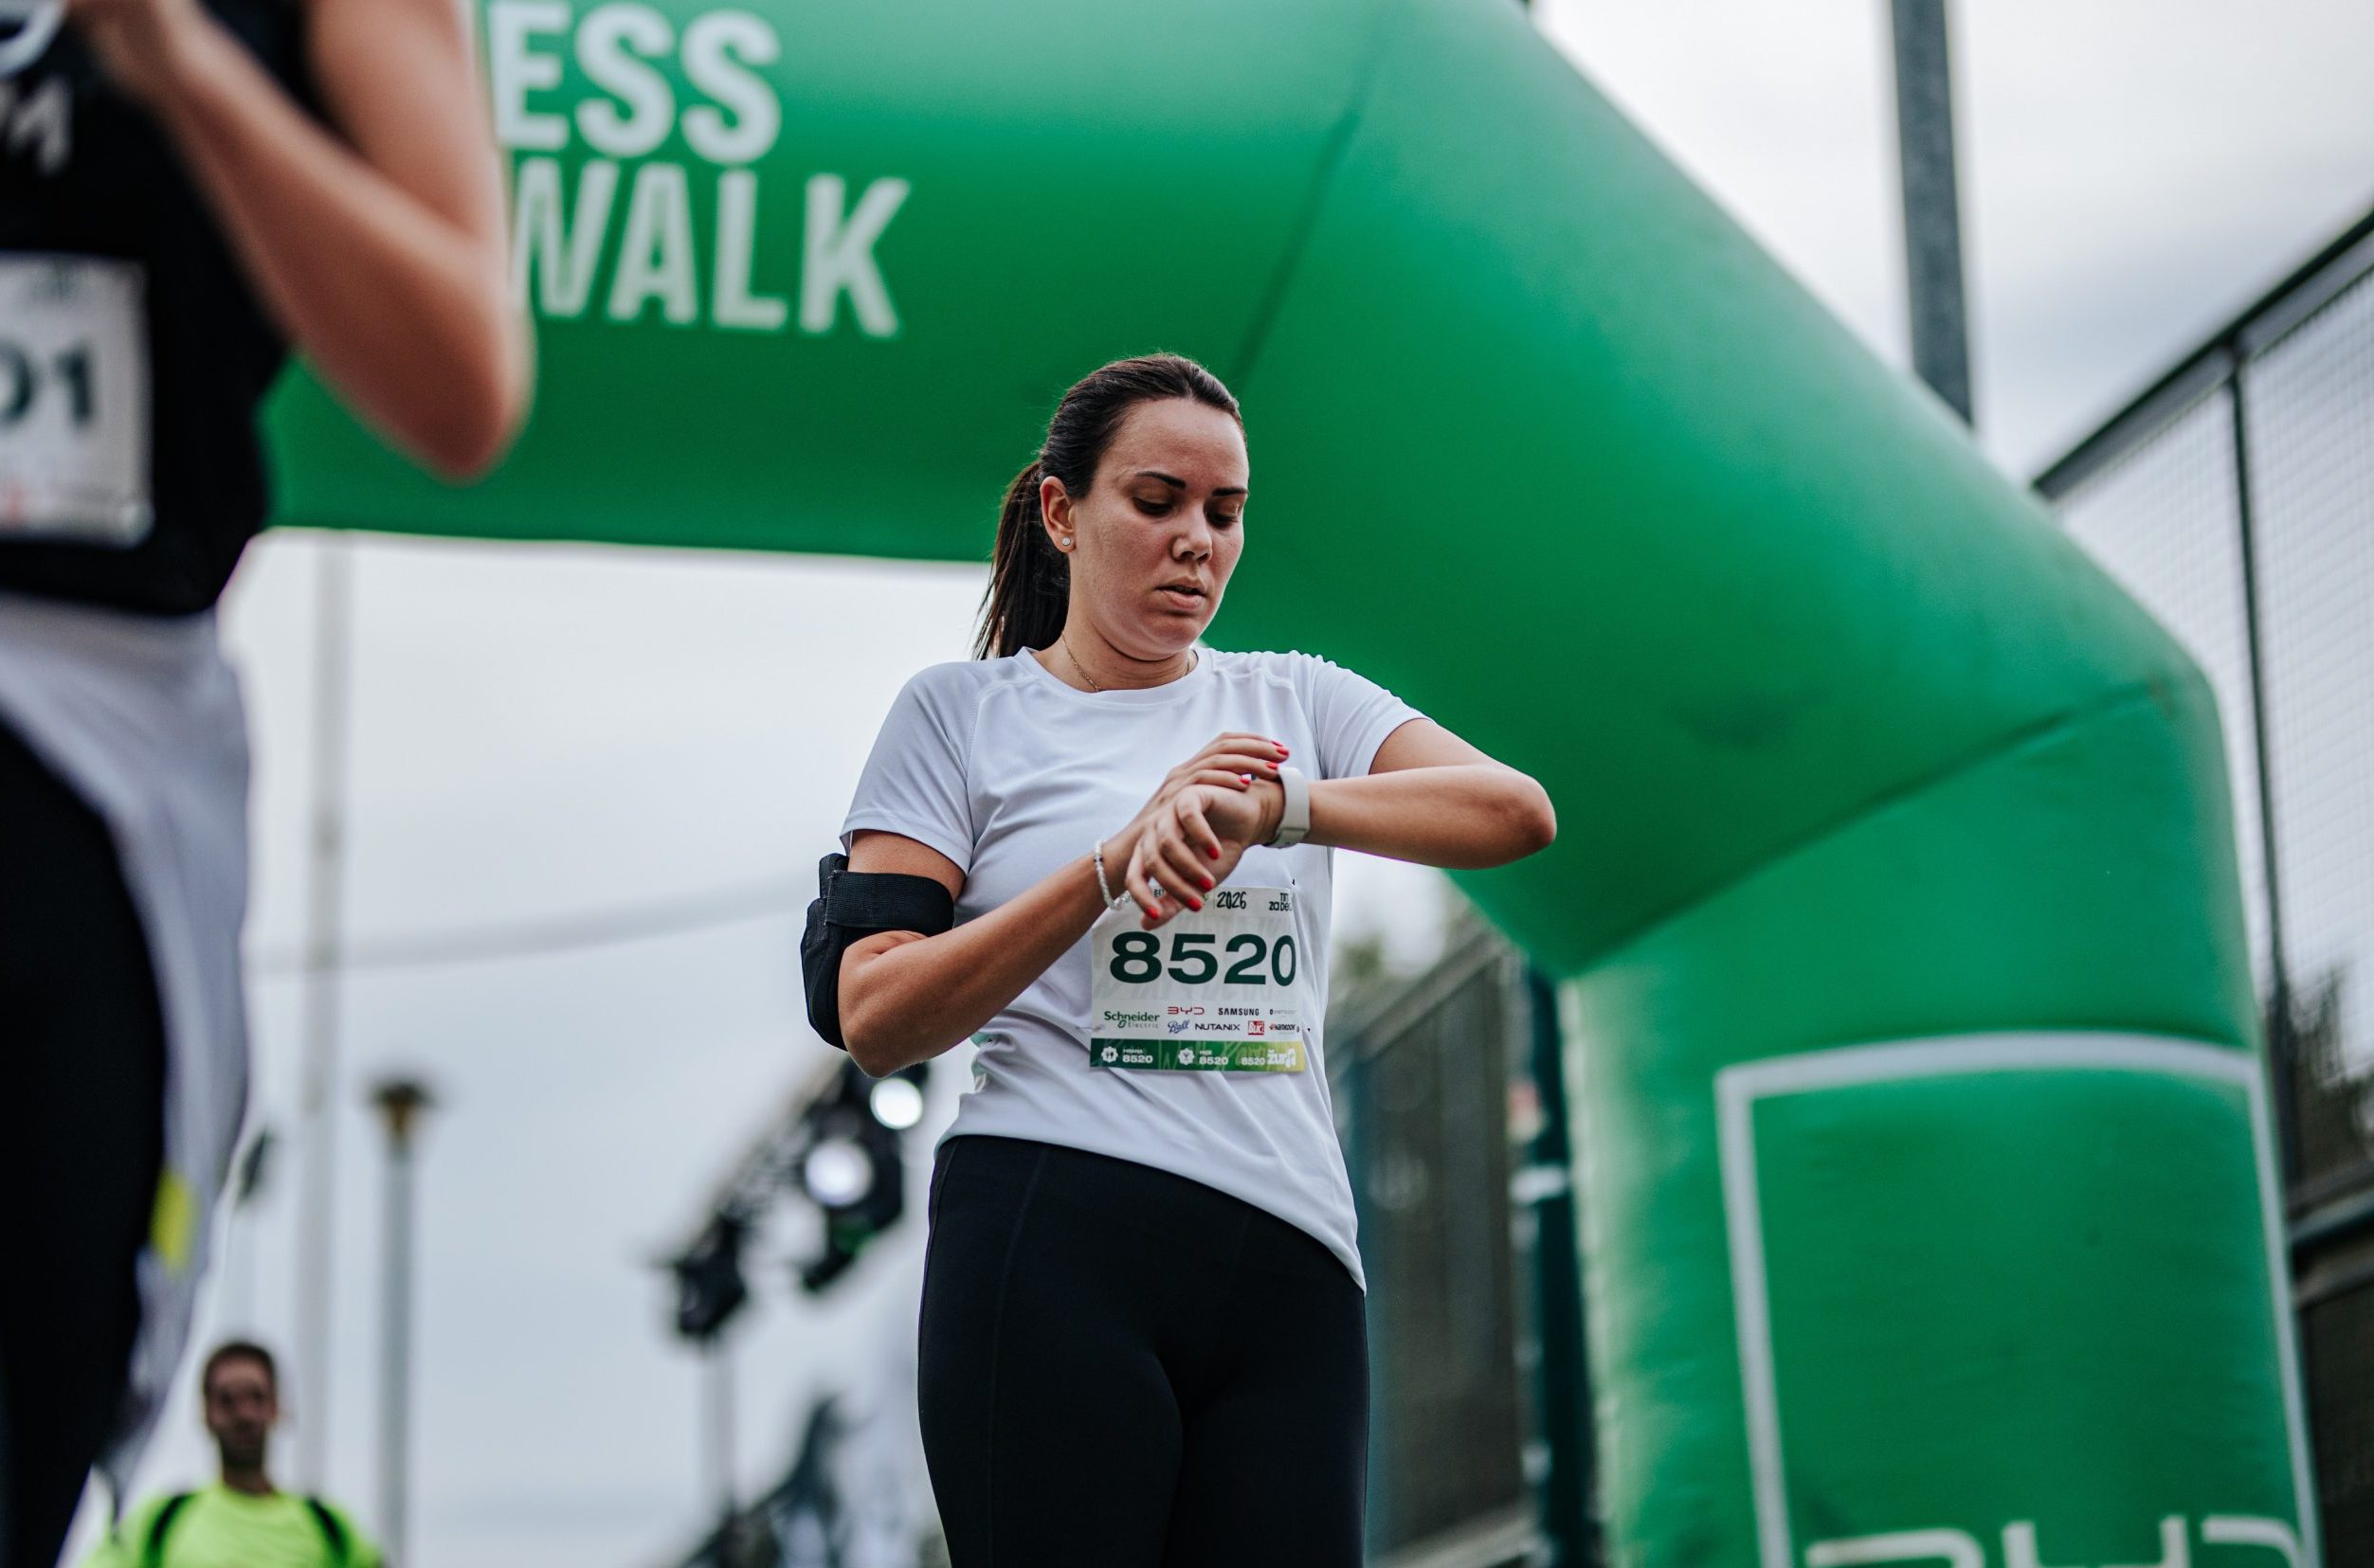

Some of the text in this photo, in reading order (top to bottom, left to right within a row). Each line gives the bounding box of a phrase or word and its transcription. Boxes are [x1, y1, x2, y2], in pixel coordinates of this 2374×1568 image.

[512, 157, 911, 339] WALK
[1217, 891, 1247, 910] 2026
[1110, 931, 1296, 986] 8520
[1168, 1006, 1205, 1016] BYD
[1218, 1007, 1259, 1016] SAMSUNG
[1104, 1011, 1160, 1022] Schneider
[1122, 1054, 1153, 1064] 8520
[1199, 1056, 1229, 1065] 8520
[1241, 1056, 1265, 1066] 8520
